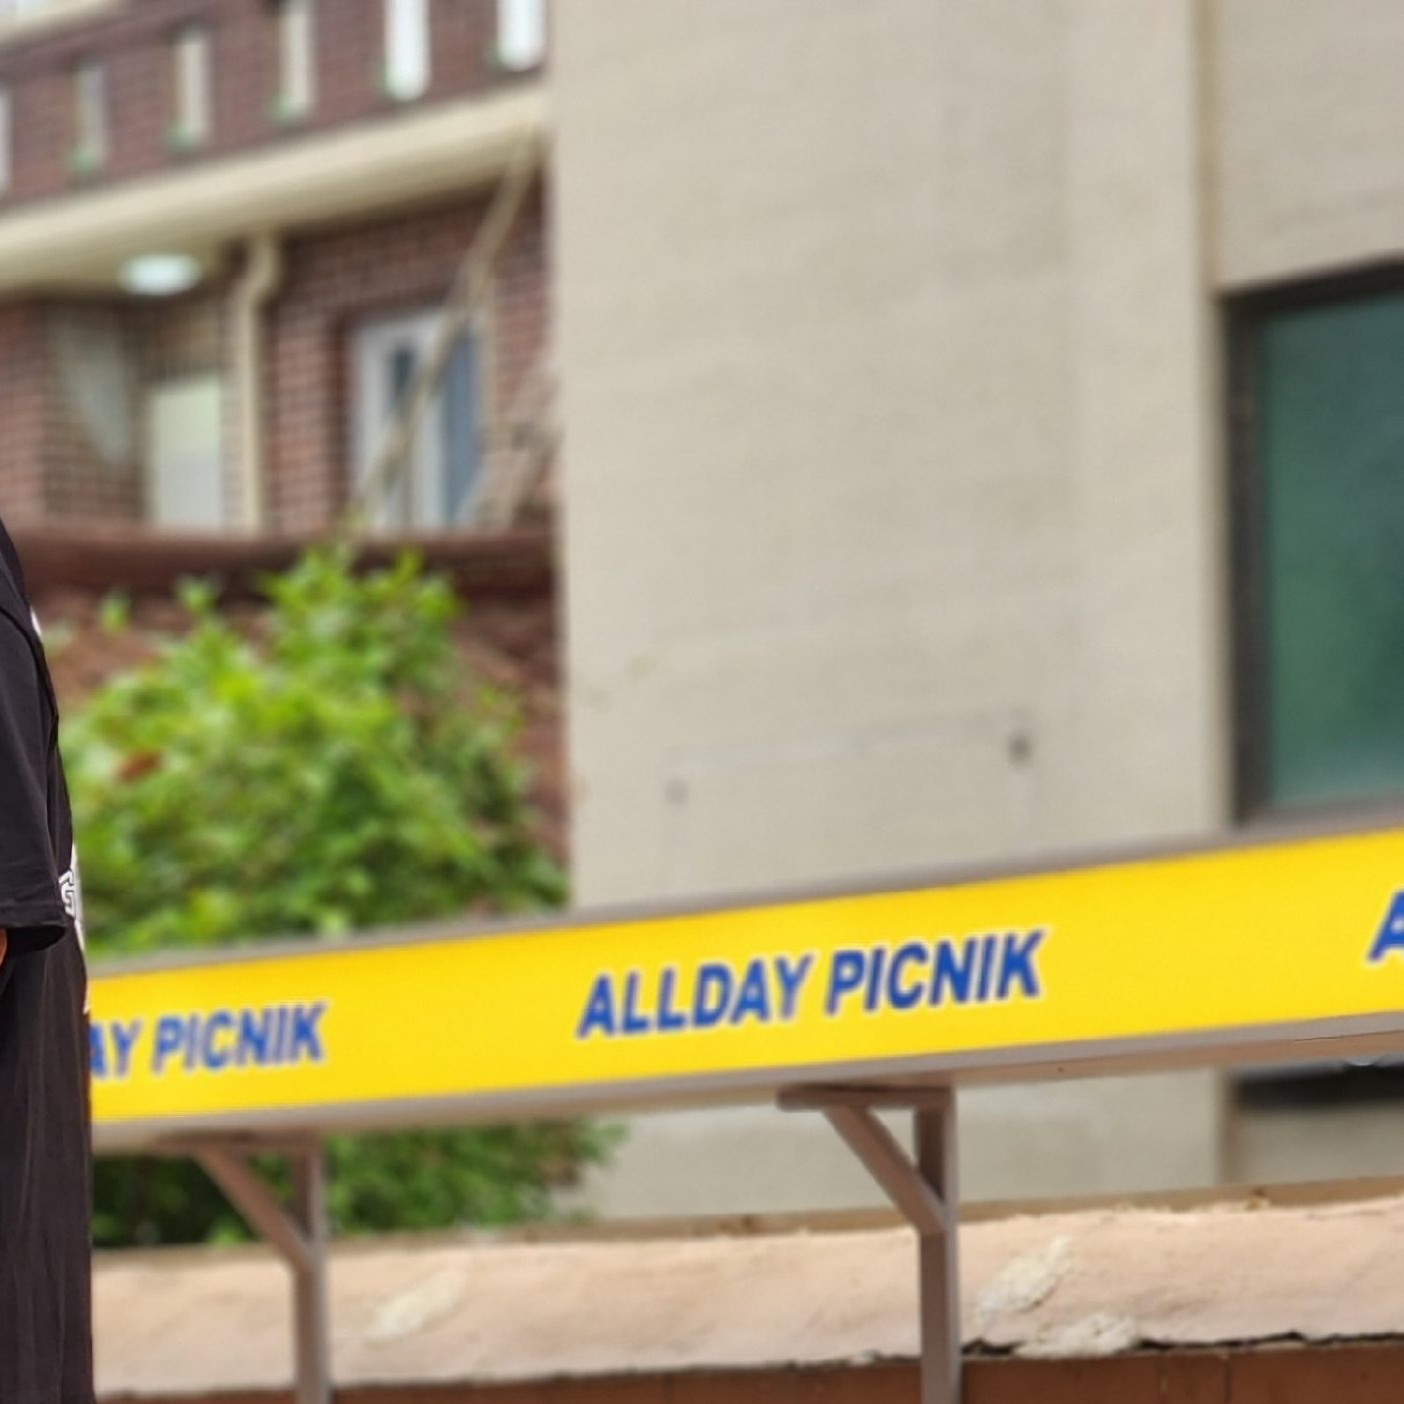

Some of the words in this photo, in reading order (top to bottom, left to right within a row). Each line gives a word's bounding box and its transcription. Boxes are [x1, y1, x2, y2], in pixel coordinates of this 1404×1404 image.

[576, 953, 815, 1039] ALLDAY
[824, 928, 1046, 1017] PICNIK
[152, 1000, 327, 1075] PICNIK
